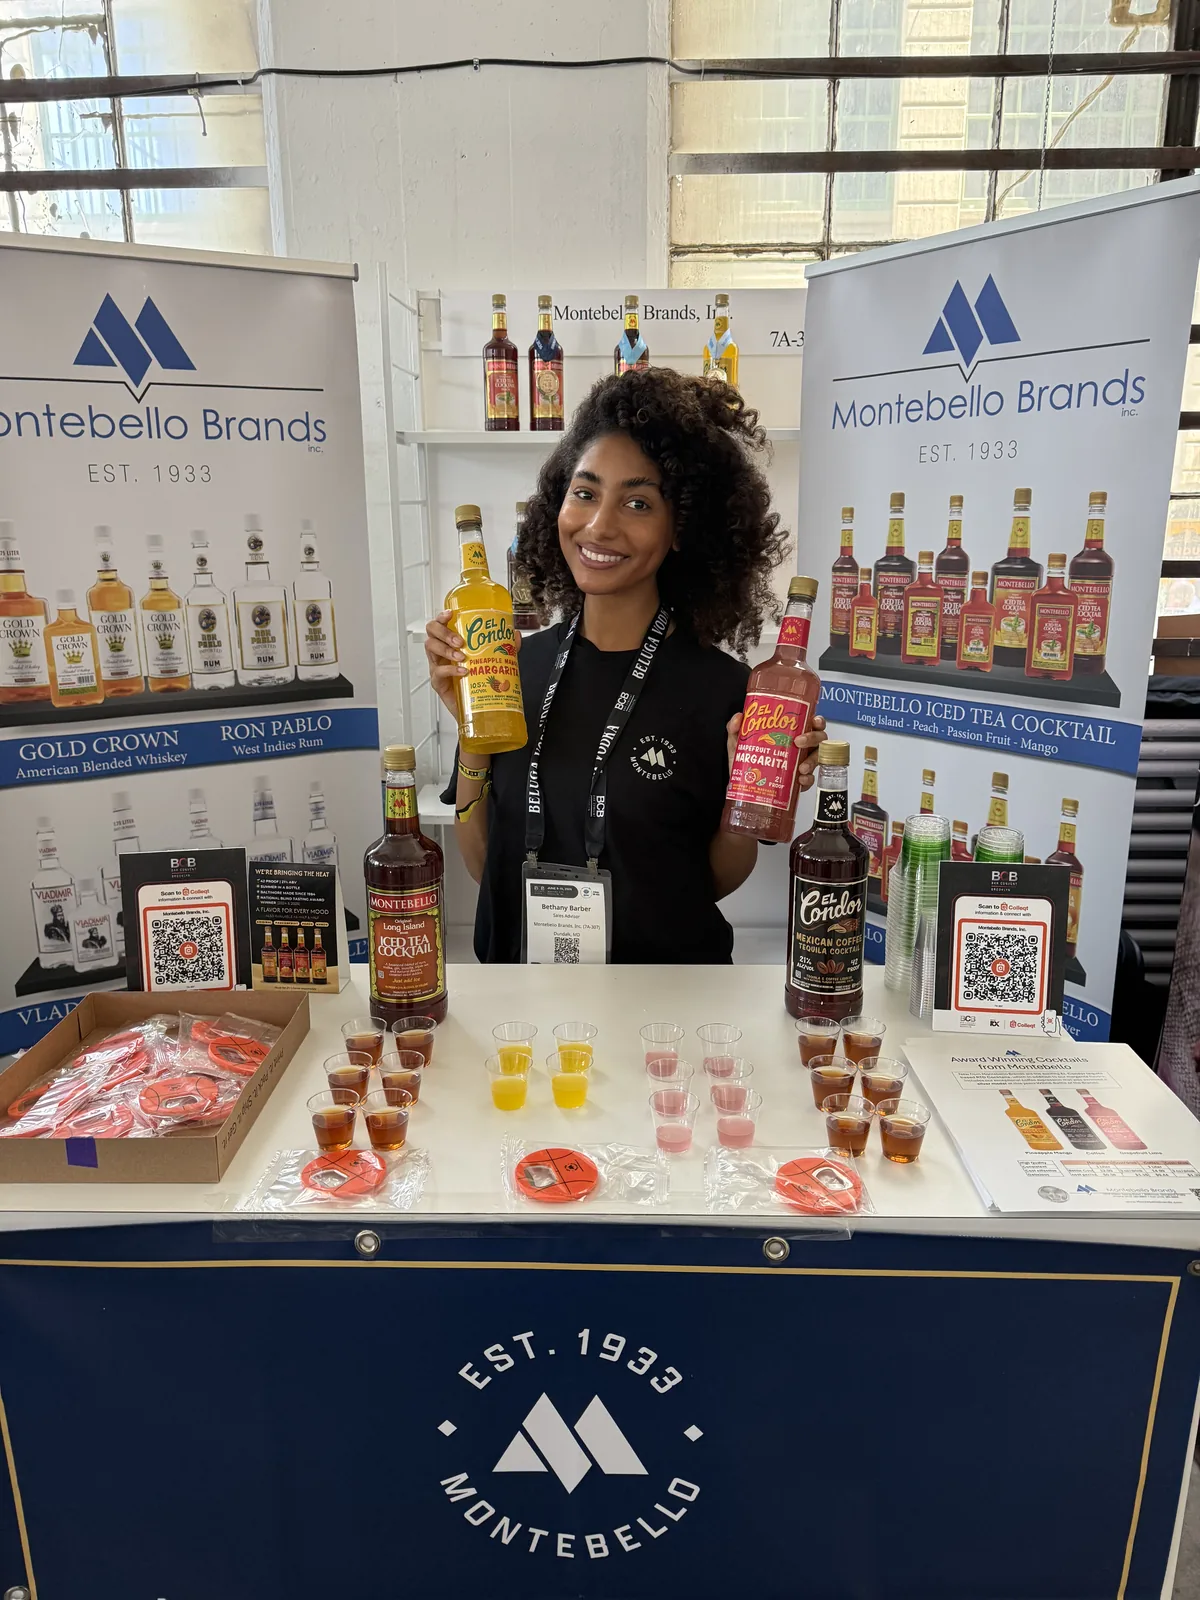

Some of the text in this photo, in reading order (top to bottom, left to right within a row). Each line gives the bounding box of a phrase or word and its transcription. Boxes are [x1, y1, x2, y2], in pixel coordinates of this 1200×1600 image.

[553, 305, 700, 322] Montebel Brands,
[832, 368, 1146, 430] Montebello Brands
[1121, 407, 1138, 417] inc.
[0, 405, 327, 442] ontebello Brands
[308, 445, 324, 454] inc.
[919, 440, 1018, 463] EST. 1933
[88, 464, 212, 483] EST. 1933
[880, 575, 910, 584] MONTEBELLO
[997, 579, 1034, 589] MONTEBELLO
[1071, 584, 1110, 593] MONTEBELLO
[3, 619, 34, 628] GOLD
[100, 614, 126, 623] GOLD
[150, 614, 176, 622] GOLD
[485, 618, 497, 630] EL
[97, 624, 132, 634] CROWN
[147, 622, 181, 632] CROWN
[0, 630, 40, 639] CROWN
[466, 618, 515, 650] Condor
[56, 642, 88, 650] CROWN
[470, 658, 502, 666] PINEAPPLE
[632, 635, 660, 679] BELUGA
[614, 691, 630, 710] BCB
[757, 704, 771, 715] EL
[820, 686, 1116, 745] MONTEBELLO ICED TEA COCKTAIL
[741, 702, 799, 736] Condor
[220, 716, 332, 741] RON PABLO
[857, 711, 1058, 755] Long Island Peach Passion Fruit Mango
[20, 730, 179, 760] GOLD CROWN
[232, 738, 324, 756] West Indies Rum
[640, 736, 677, 754] EST. 1933
[773, 749, 789, 758] LIME
[16, 752, 188, 779] American Blended Whiskey
[736, 752, 788, 770] MARGARITA
[630, 756, 673, 780] MONTEBELLO
[528, 762, 540, 814] BELUGA
[596, 795, 605, 818] BCB
[856, 818, 883, 830] MONTEBELLO
[306, 847, 334, 859] VLADIMIR
[170, 857, 196, 868] BCB
[992, 871, 1018, 881] BCB
[35, 888, 73, 900] VLADIMIR
[822, 893, 837, 905] EL
[371, 894, 437, 909] MONTEBELLO
[800, 890, 863, 925] Condor
[542, 904, 568, 912] Bethany
[74, 915, 110, 927] VLADIMIR
[383, 921, 425, 932] Long Island
[380, 936, 406, 947] ICED
[408, 934, 429, 946] TEA
[796, 932, 833, 947] MEXICAN
[836, 934, 862, 947] COFFEE
[378, 943, 433, 958] COCKTAIL
[798, 943, 860, 955] TEQUILA COCKTAIL
[800, 956, 812, 965] 21%
[987, 1056, 1035, 1064] Winning
[458, 1328, 683, 1393] EST. 1933
[440, 1472, 700, 1559] MONTEBELLO
